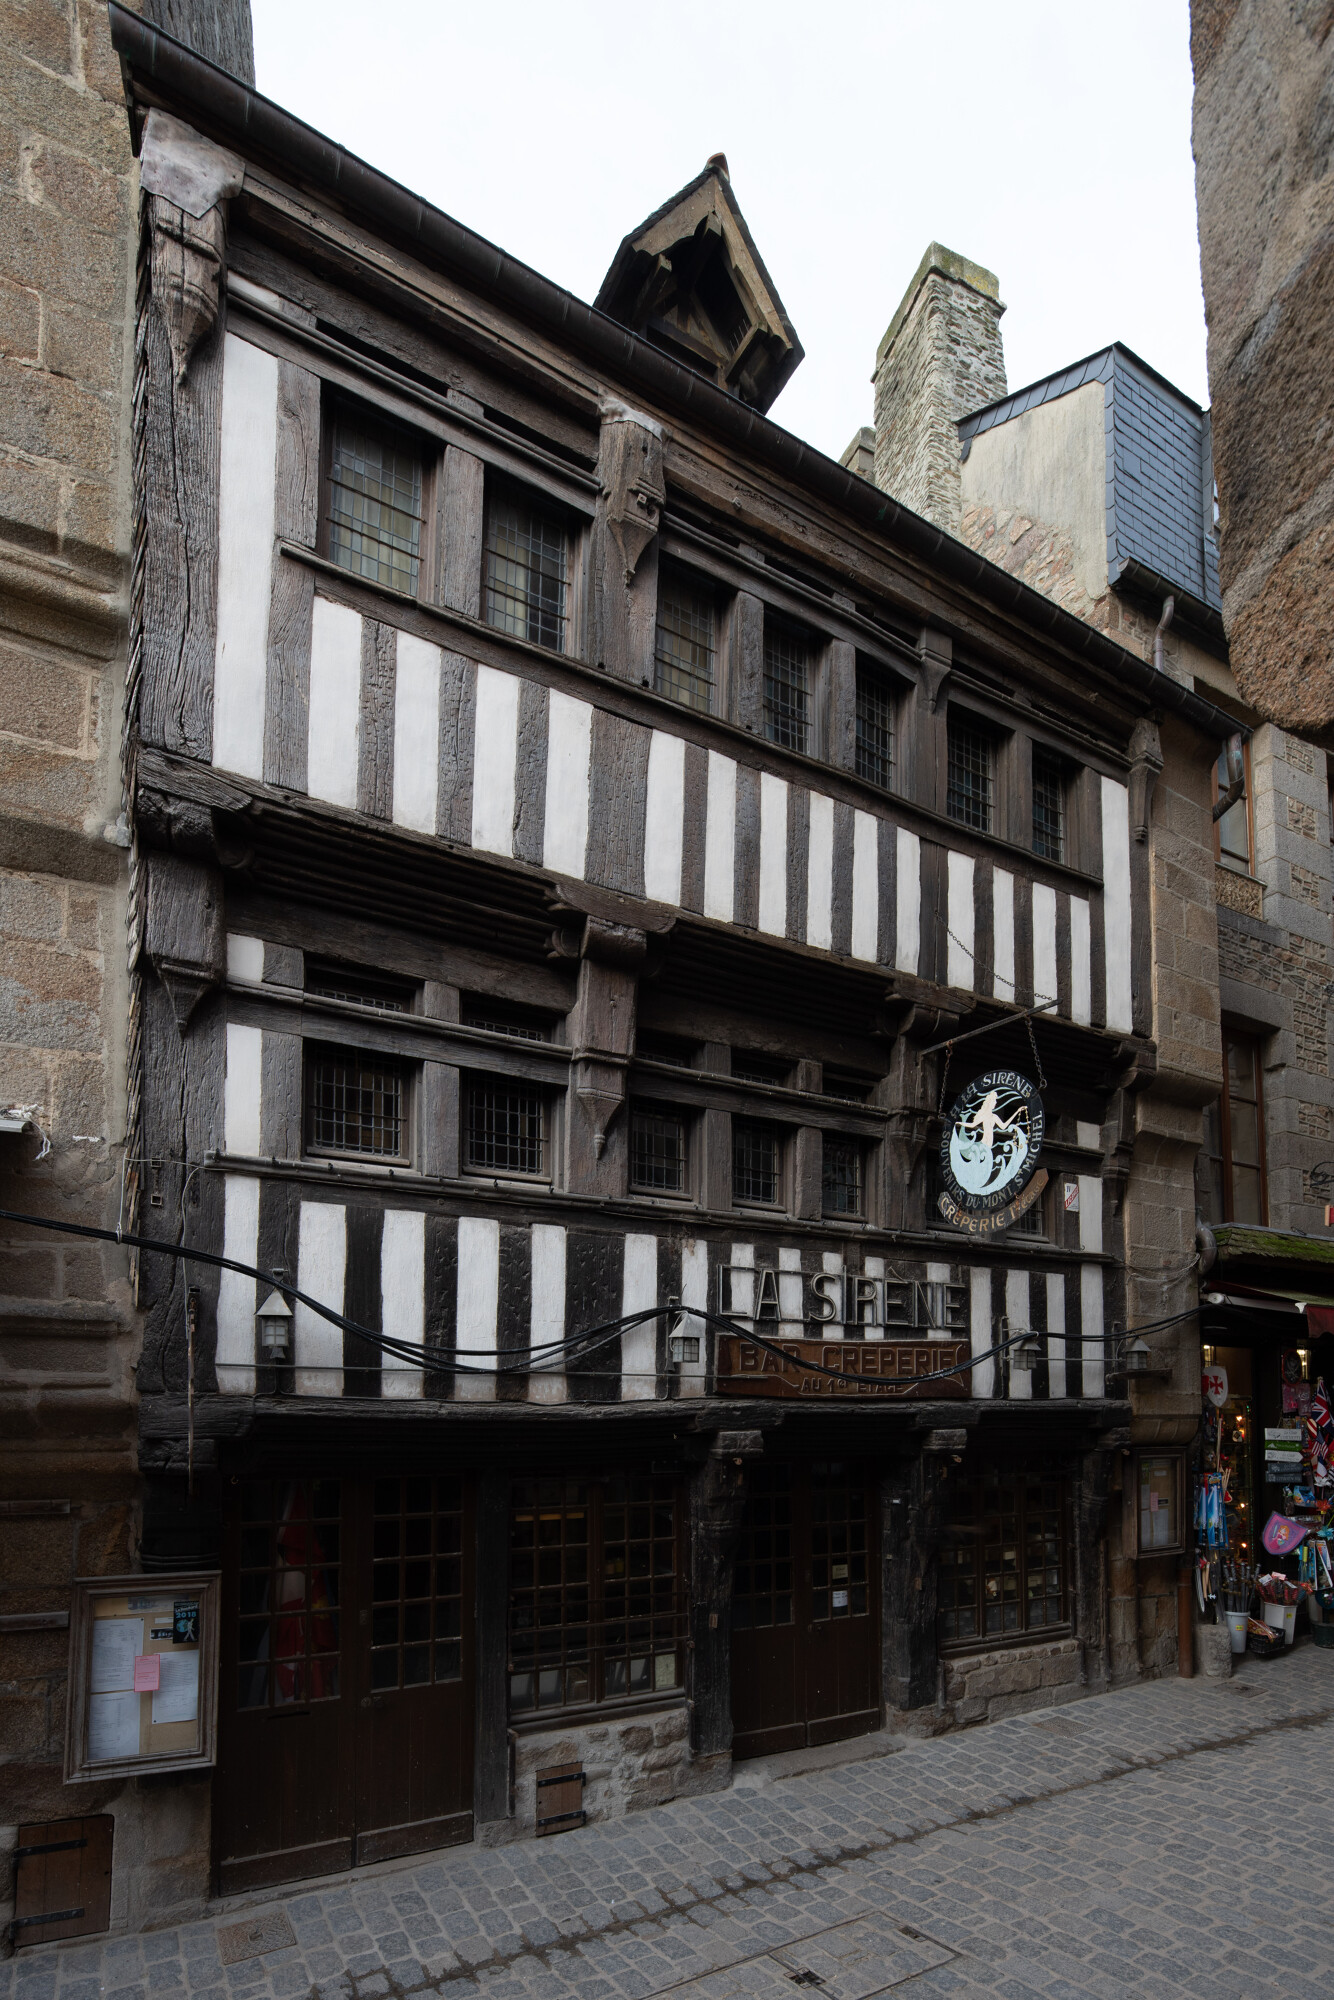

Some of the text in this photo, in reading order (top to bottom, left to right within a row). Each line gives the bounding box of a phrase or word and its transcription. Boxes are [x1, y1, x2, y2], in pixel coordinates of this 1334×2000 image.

[961, 1082, 978, 1103] LA
[940, 1129, 966, 1202] SOUVENIRS
[965, 1196, 981, 1209] DU
[982, 1184, 1013, 1208] MONT
[1023, 1110, 1043, 1173] MICHEL
[717, 1264, 967, 1330] LA SIRÈNE
[801, 1377, 822, 1393] AU
